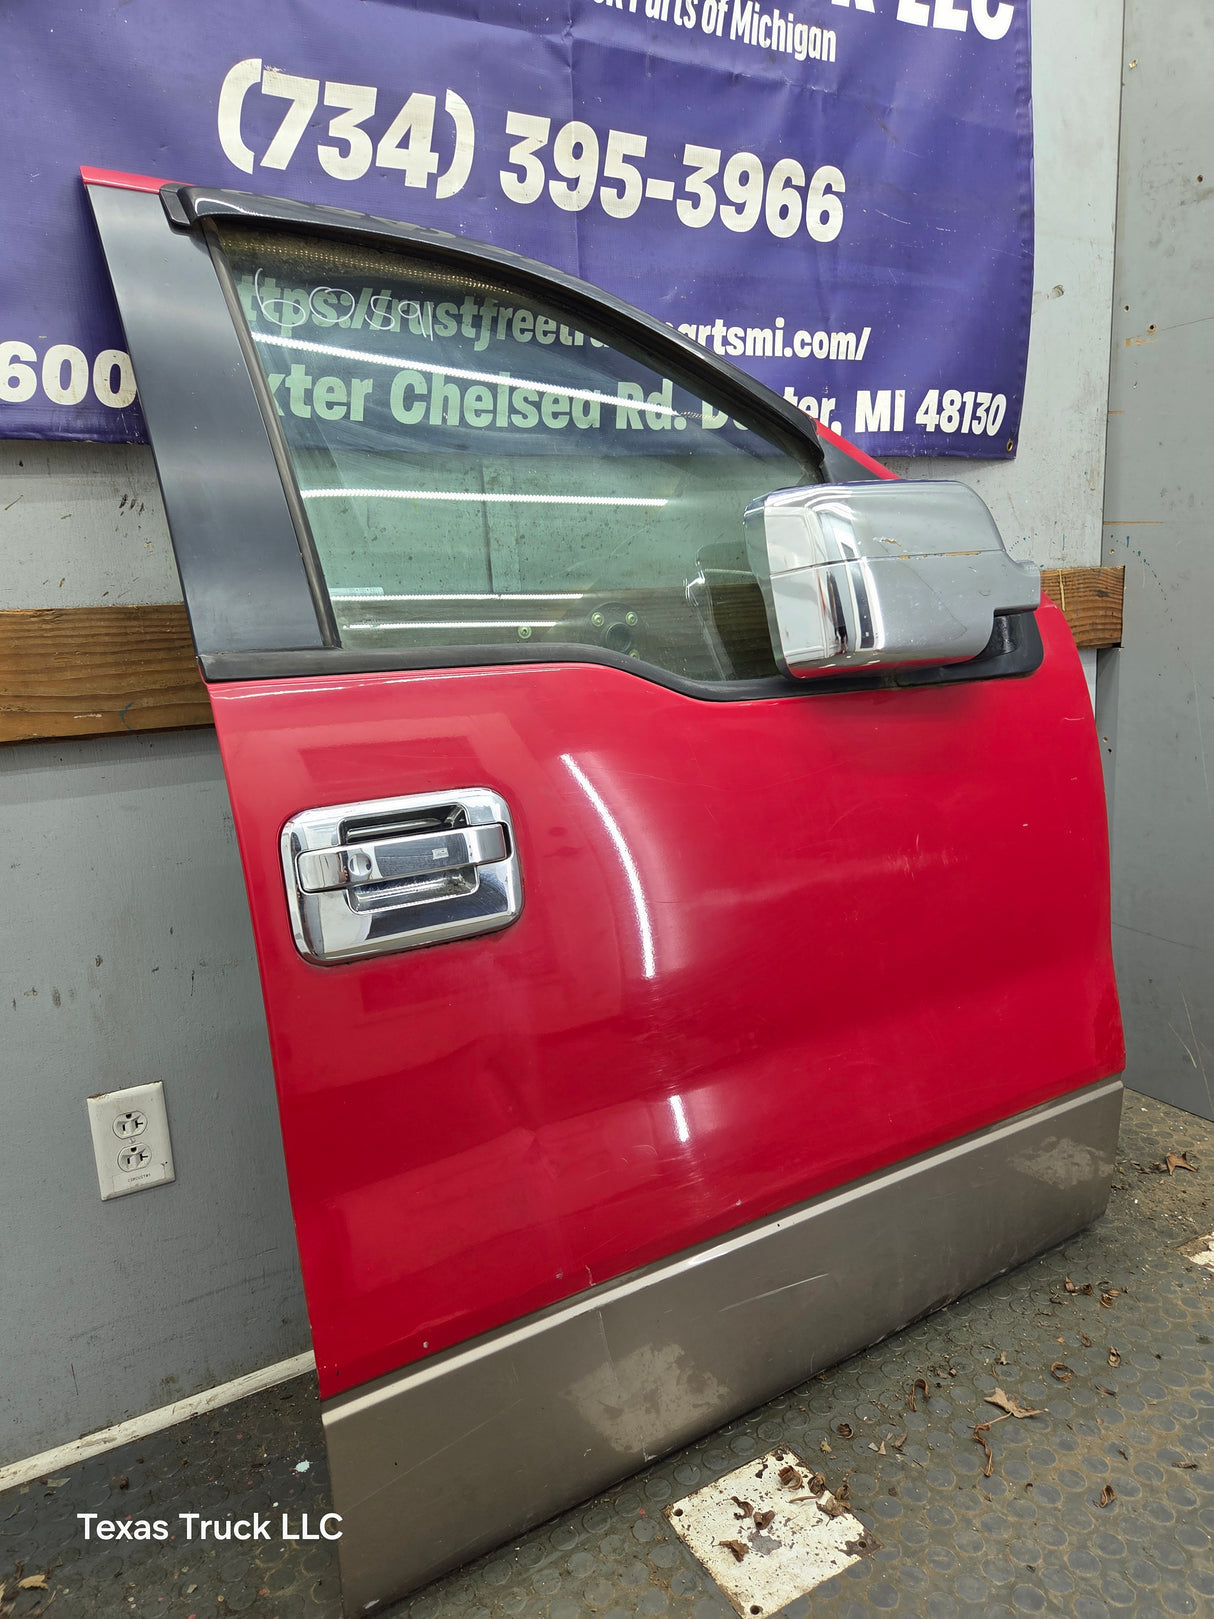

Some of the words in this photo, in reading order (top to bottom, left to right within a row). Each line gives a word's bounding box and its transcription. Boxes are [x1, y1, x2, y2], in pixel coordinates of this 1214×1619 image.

[729, 0, 837, 62] Michigan
[217, 58, 475, 199] (734)
[499, 111, 845, 242] 395-3966
[390, 368, 601, 430] Chelsea
[616, 378, 687, 431] Rd.
[855, 389, 905, 433] MI
[915, 389, 1007, 437] 48130
